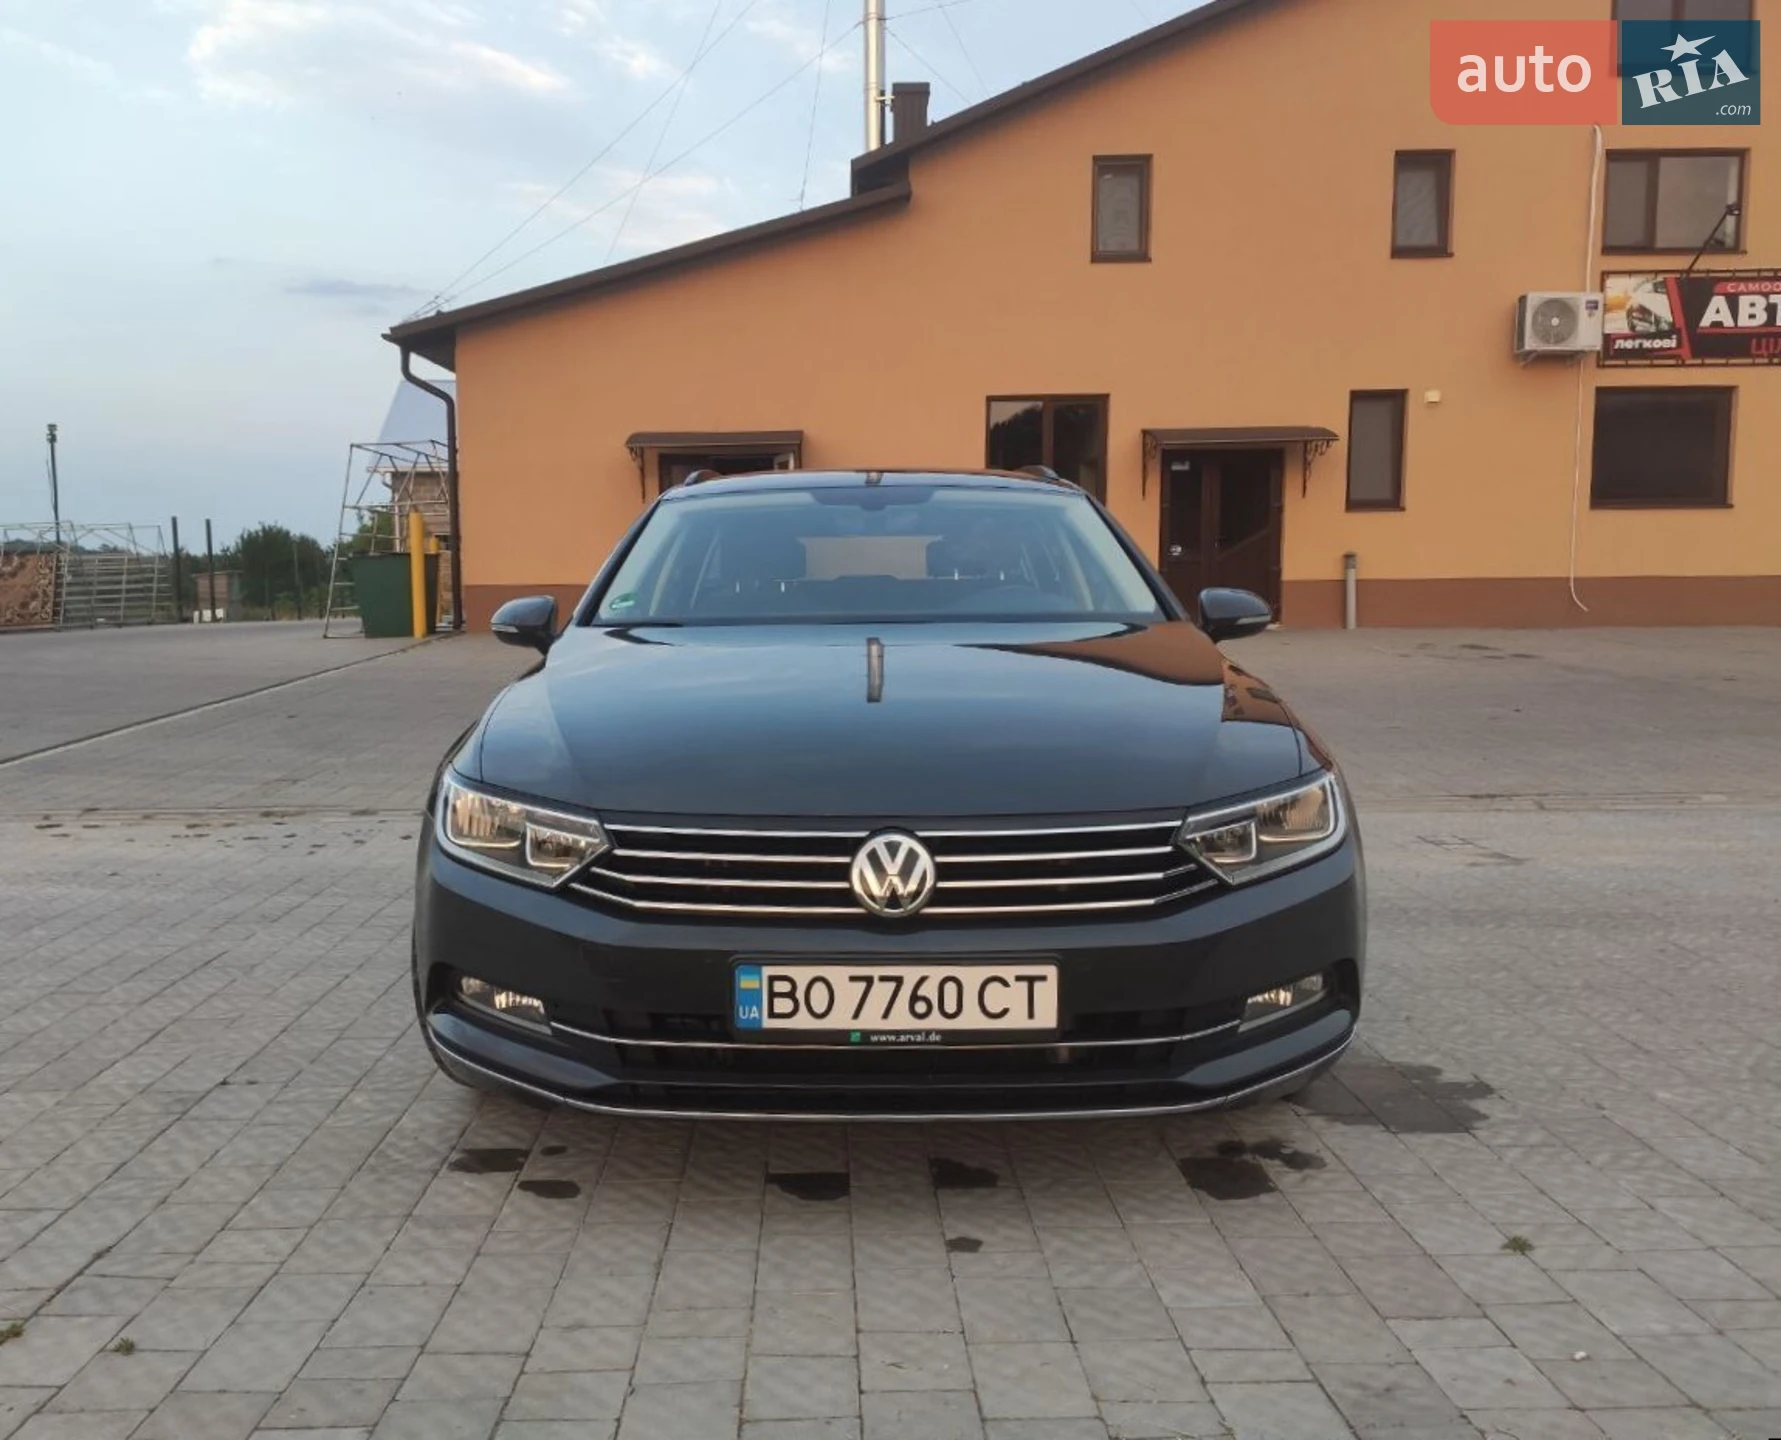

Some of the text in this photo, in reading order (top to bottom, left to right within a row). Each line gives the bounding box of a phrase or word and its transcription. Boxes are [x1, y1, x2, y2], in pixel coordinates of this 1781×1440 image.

[1614, 334, 1677, 349] легкові
[767, 974, 1048, 1020] BO 7760 CT
[738, 1005, 760, 1020] UA
[870, 1031, 942, 1043] www.arval.de
